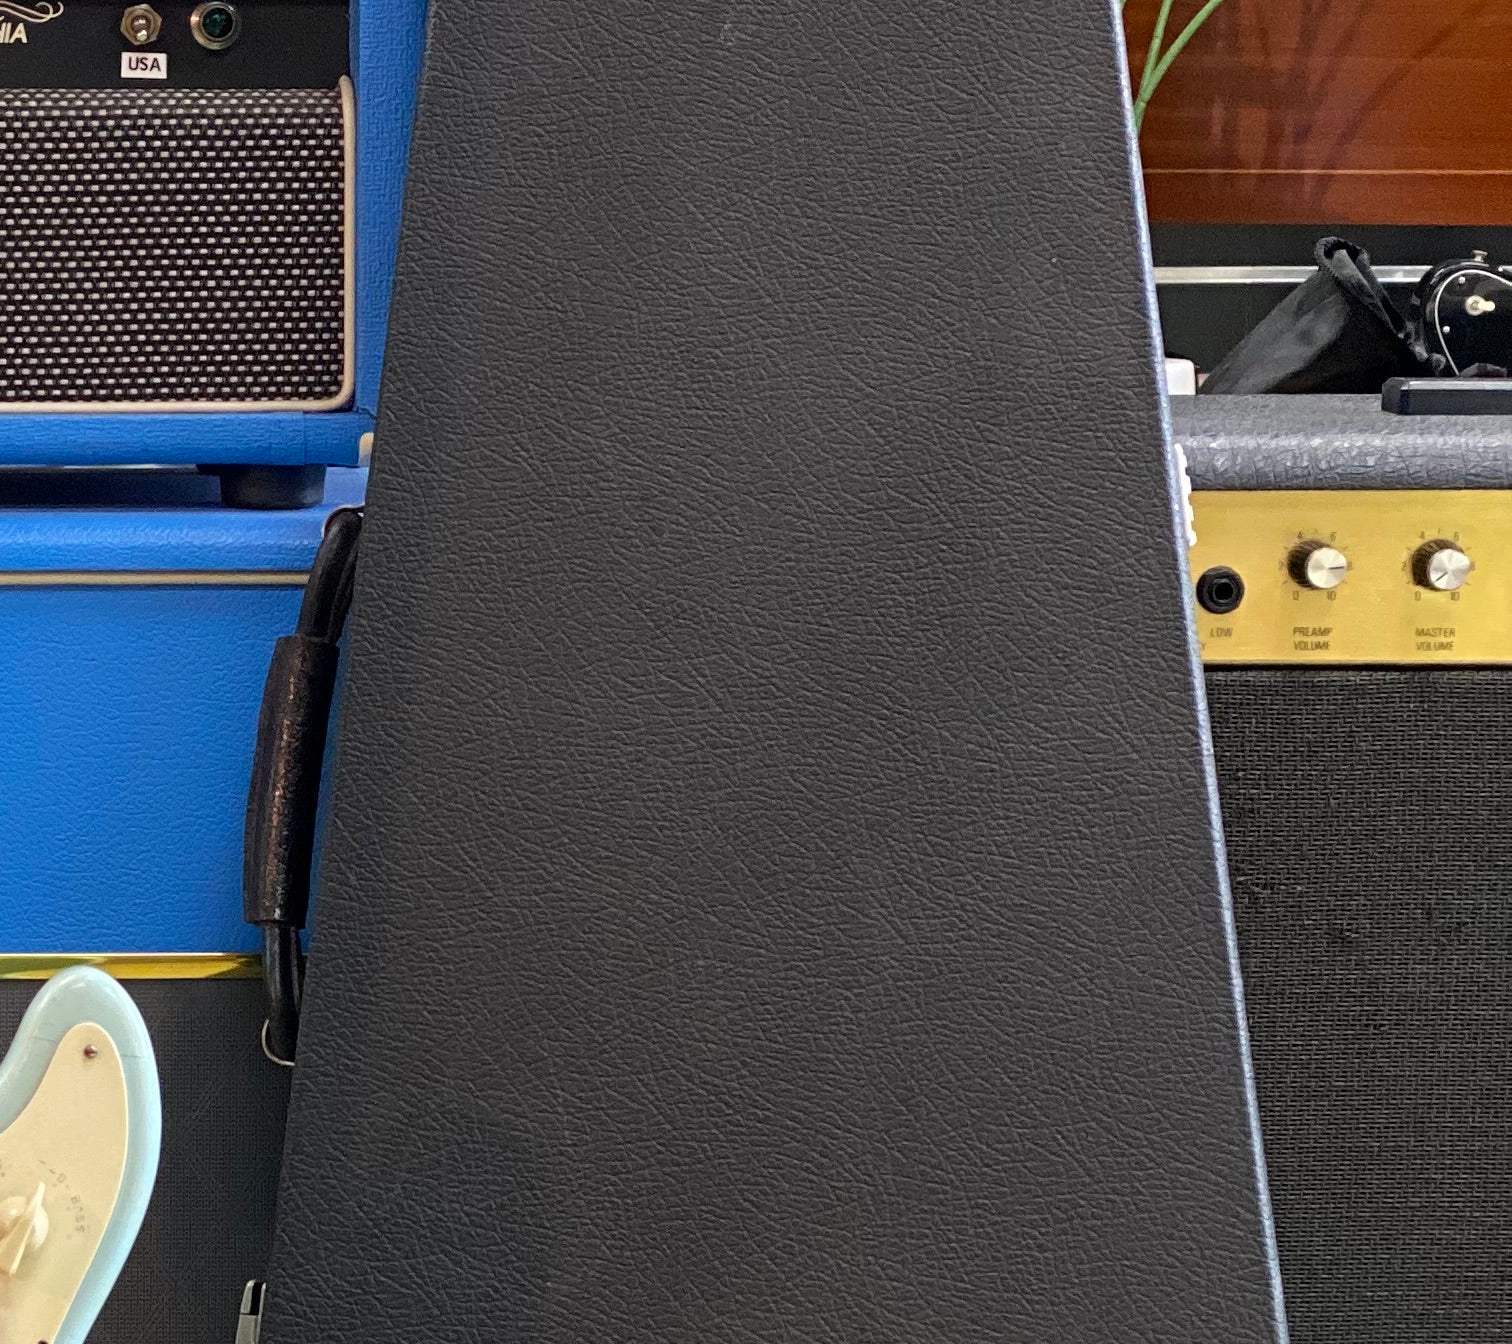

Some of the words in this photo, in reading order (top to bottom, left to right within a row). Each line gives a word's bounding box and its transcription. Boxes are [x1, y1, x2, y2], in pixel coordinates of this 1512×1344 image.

[127, 57, 162, 72] USA
[1210, 627, 1234, 638] LOW
[1292, 627, 1333, 637] PREAMP
[1415, 627, 1455, 638] MASTER
[1293, 641, 1330, 651] VOLUME
[1415, 641, 1454, 651] VOLUME
